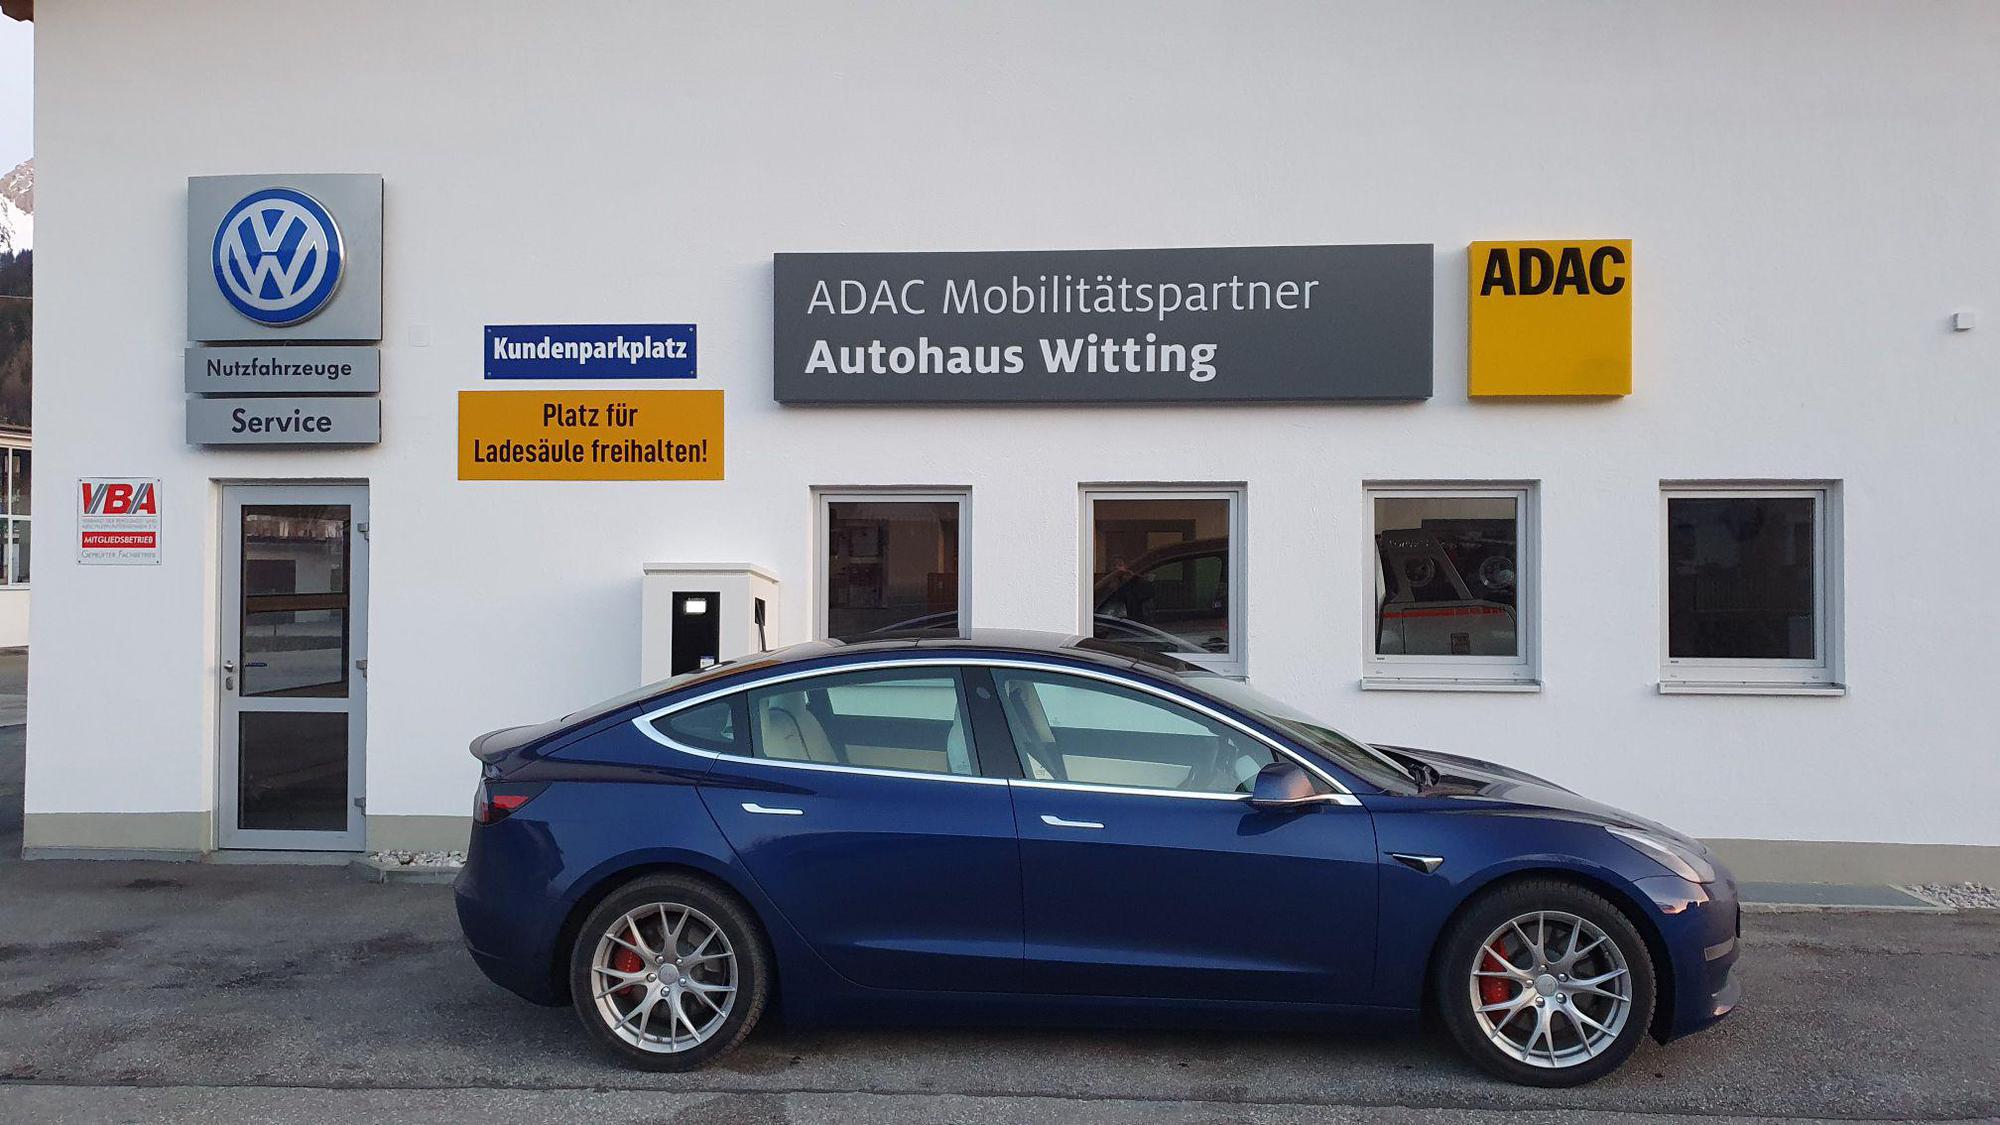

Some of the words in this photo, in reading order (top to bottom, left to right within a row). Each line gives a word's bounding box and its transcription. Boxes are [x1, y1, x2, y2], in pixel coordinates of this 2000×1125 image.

[1480, 246, 1626, 297] ADAC
[807, 279, 925, 315] ADAC
[942, 274, 1320, 321] Mobilitätspartner
[493, 336, 688, 364] Kundenparkplatz
[804, 336, 1024, 374] Autohaus
[1039, 332, 1218, 382] Witting
[206, 357, 352, 380] Nutzfahrzeuge
[231, 407, 332, 433] Service
[543, 403, 600, 427] Platz
[606, 403, 639, 427] für
[474, 438, 585, 463] Ladesäule
[591, 438, 708, 463] freihalten!
[82, 483, 157, 514] VBA
[84, 536, 153, 544] MITGLIEDSBETRIEB
